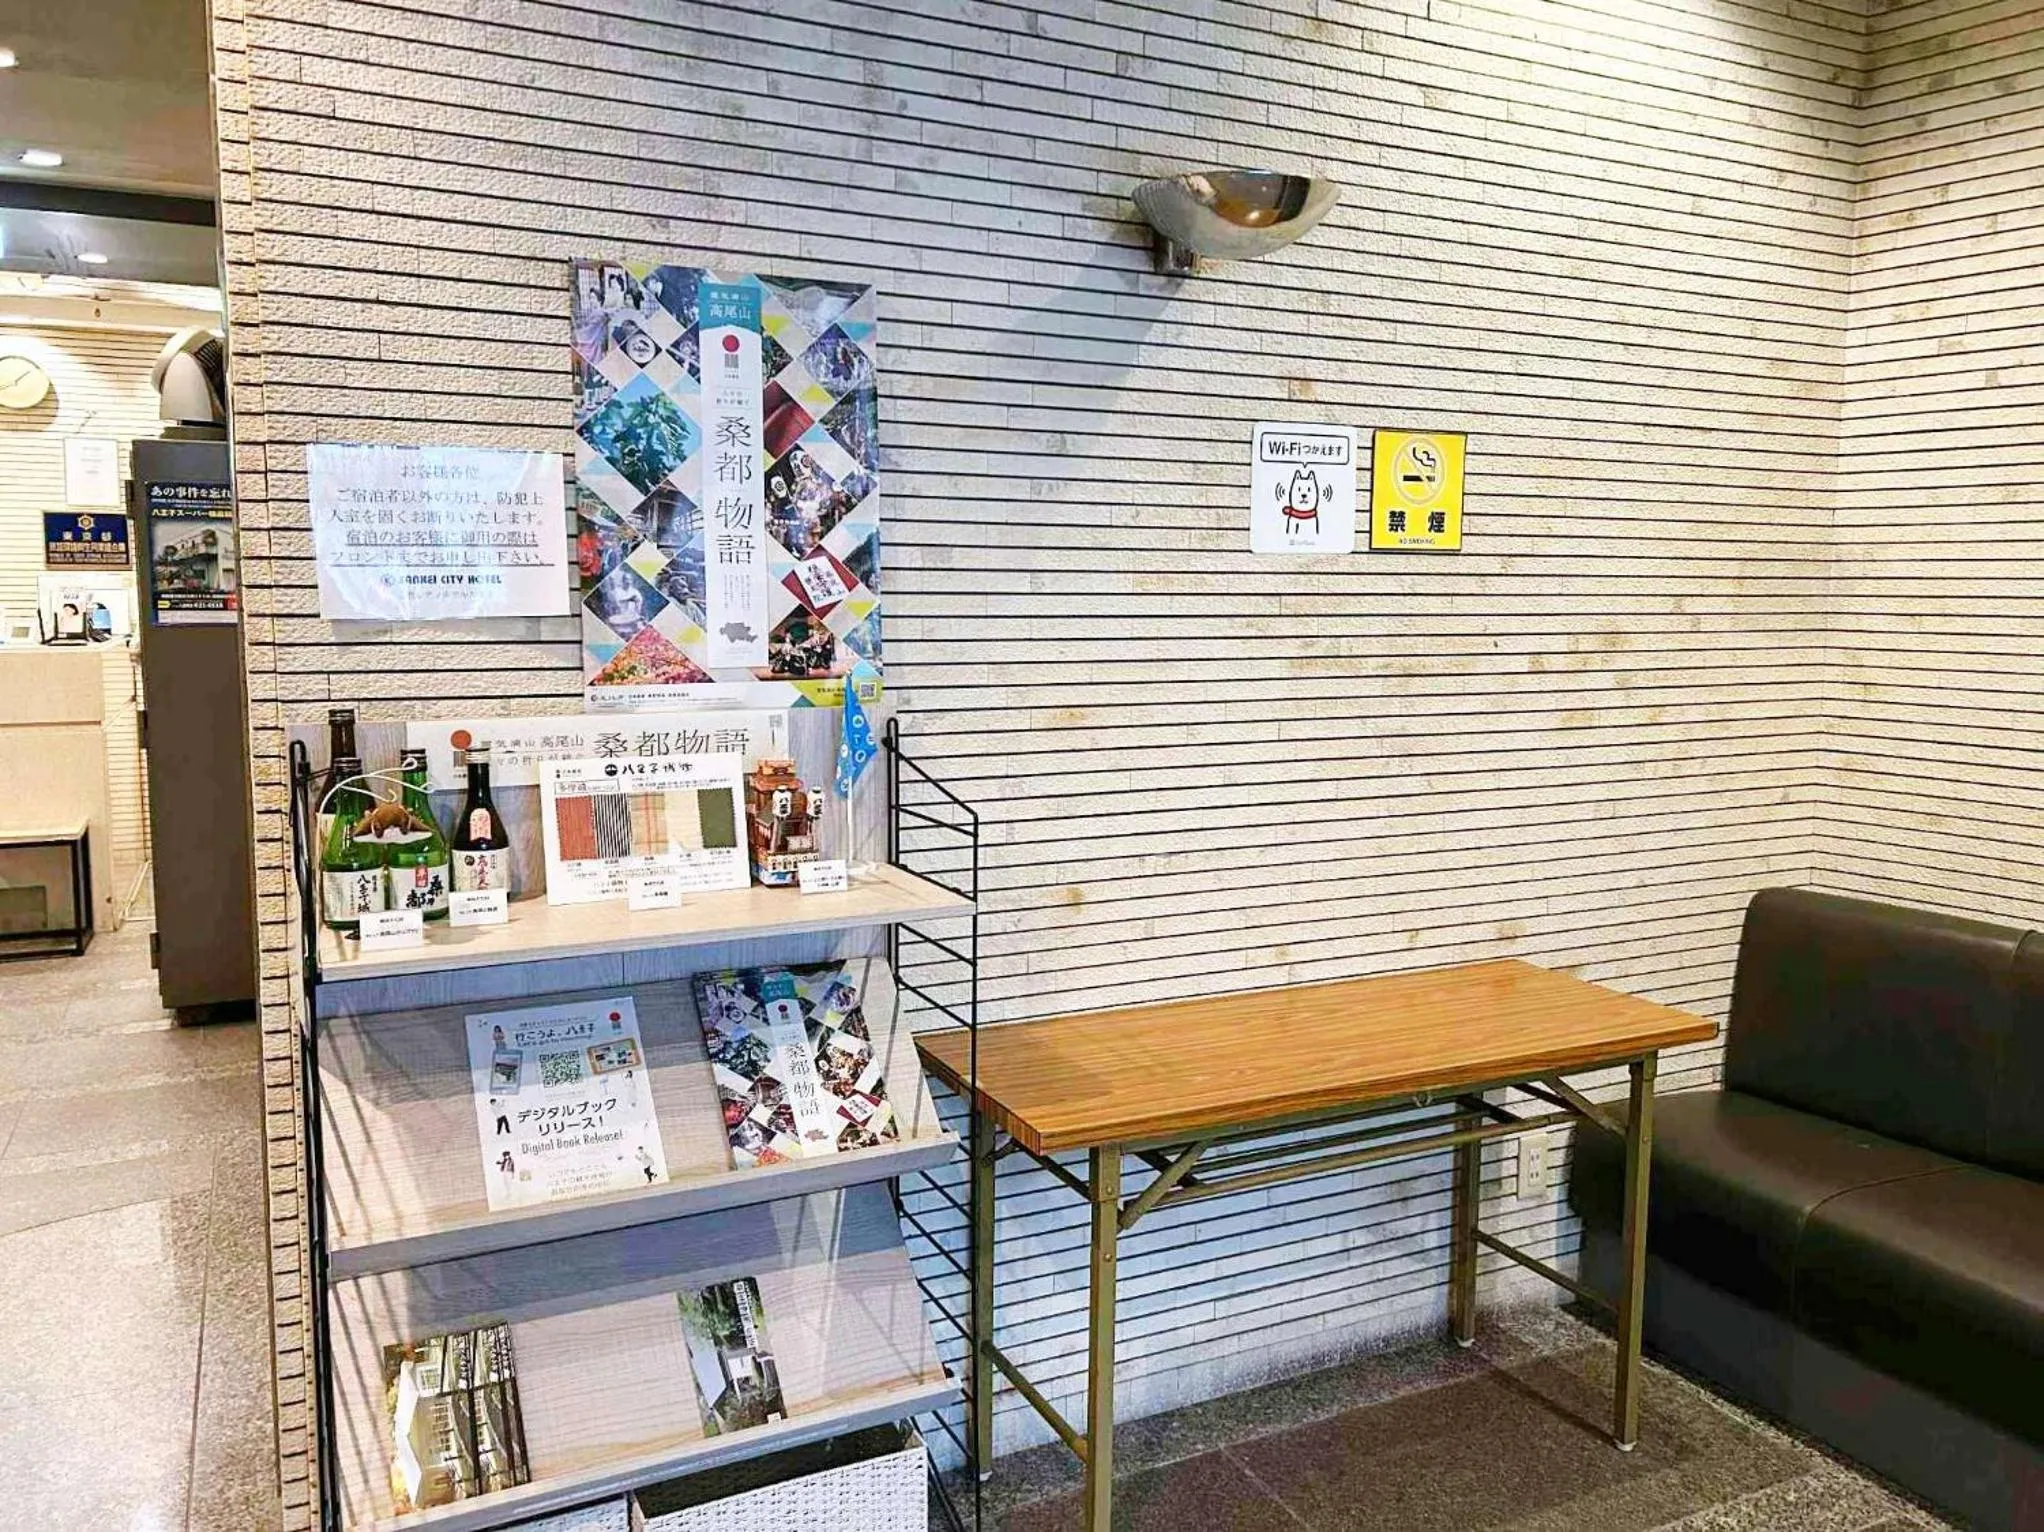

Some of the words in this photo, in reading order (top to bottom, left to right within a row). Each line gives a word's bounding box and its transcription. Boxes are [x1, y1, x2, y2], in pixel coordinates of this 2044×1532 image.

[709, 303, 751, 320] 高尾山
[712, 415, 756, 566] 桑都物語
[1388, 510, 1446, 534] 禁煙
[440, 573, 464, 585] CITY
[539, 732, 586, 750] 高尾山
[593, 727, 750, 760] 桑都物語
[784, 1042, 821, 1118] 桑都物語
[517, 1097, 618, 1124] デジタルブック
[521, 1137, 555, 1156] Digital
[556, 1136, 581, 1150] Book
[583, 1130, 624, 1147] Release!
